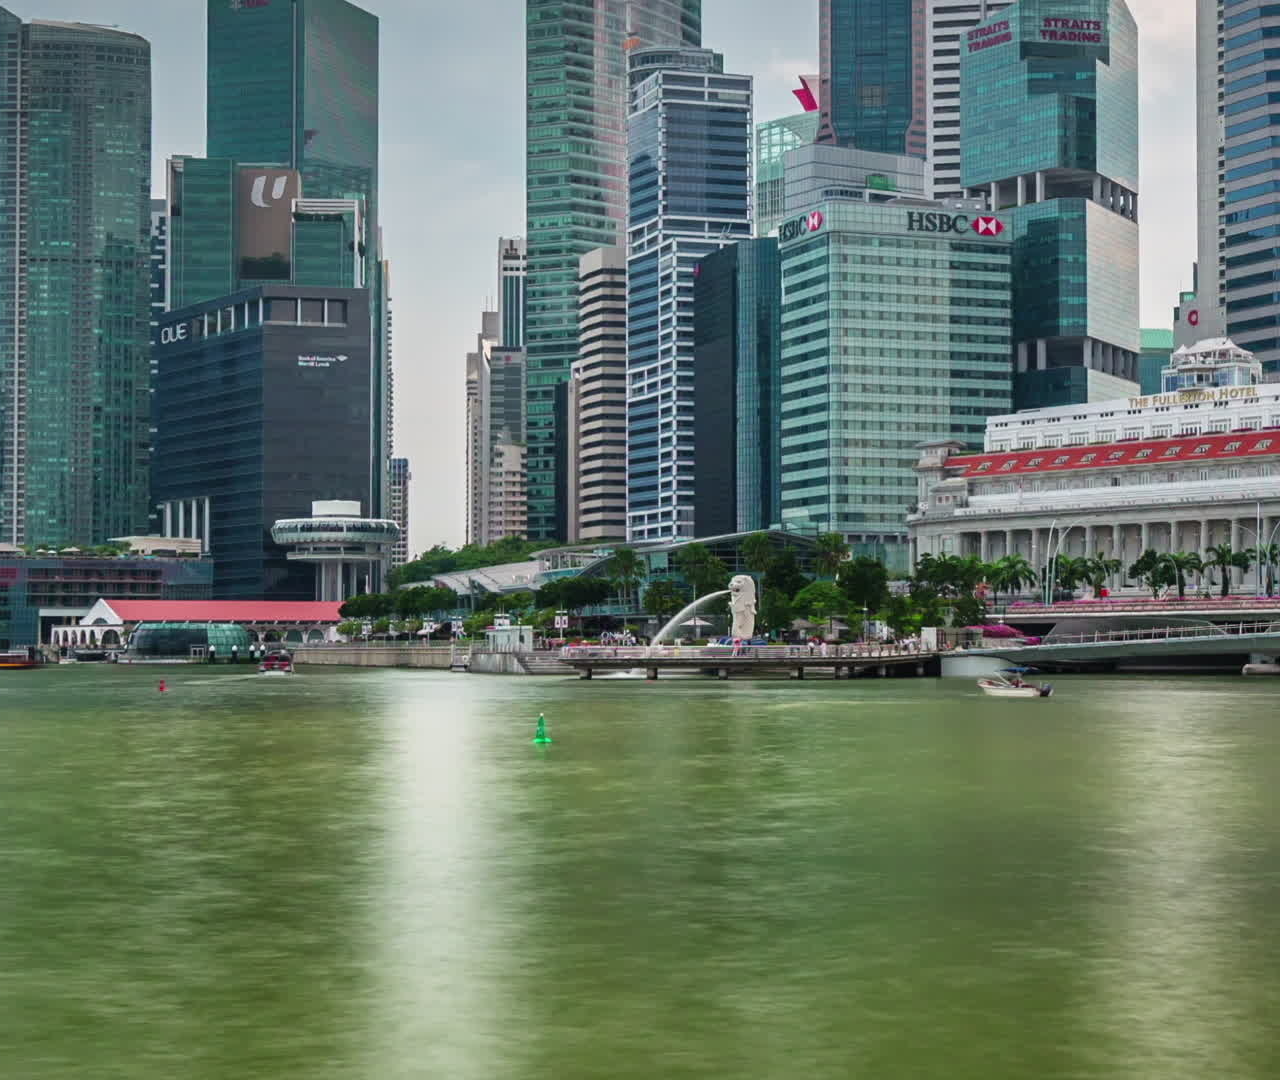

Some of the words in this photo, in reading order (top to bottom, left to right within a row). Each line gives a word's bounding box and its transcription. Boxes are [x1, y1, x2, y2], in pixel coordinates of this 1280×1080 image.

[967, 21, 1009, 40] STRAITS
[1043, 17, 1101, 30] STRAITS
[1040, 30, 1102, 43] TRADING
[907, 211, 969, 233] HSBC
[161, 323, 188, 344] OUE
[1128, 398, 1149, 409] THE
[1152, 391, 1215, 406] FULLERTON
[1219, 387, 1258, 399] HOTEL
